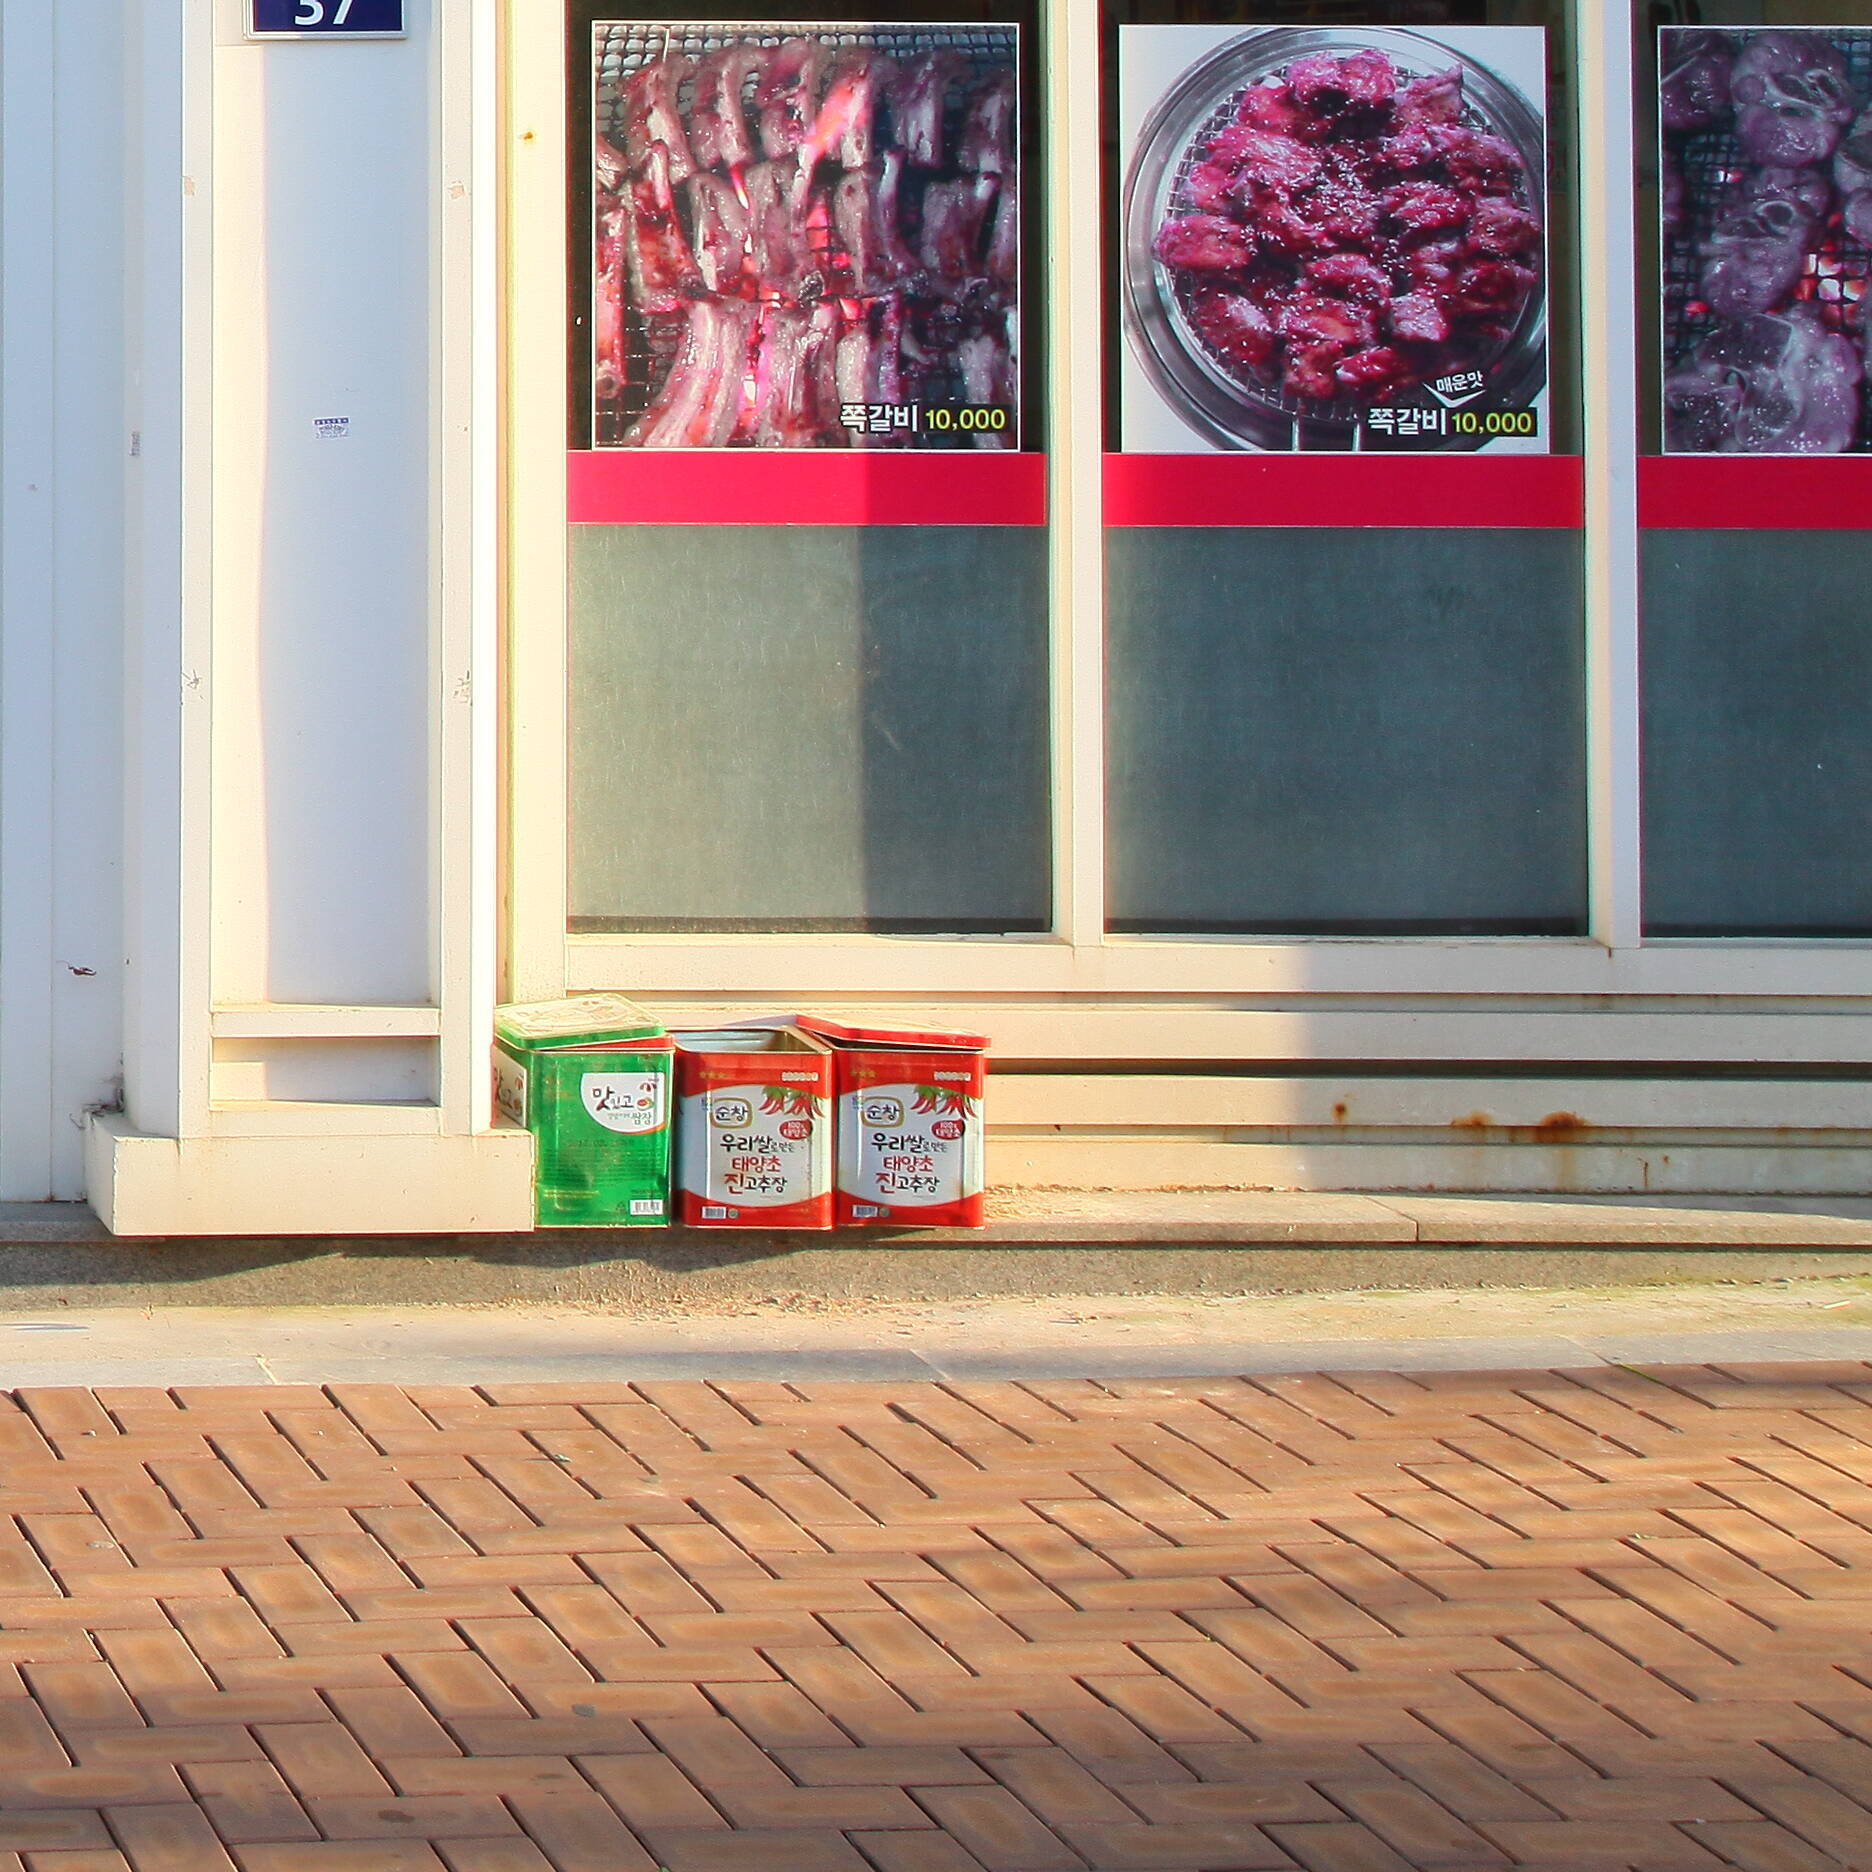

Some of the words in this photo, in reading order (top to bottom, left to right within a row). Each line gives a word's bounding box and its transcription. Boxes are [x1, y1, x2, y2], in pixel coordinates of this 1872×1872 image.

[1435, 370, 1485, 394] 매운맛
[840, 404, 918, 433] 쪽갈비
[924, 408, 1007, 431] 10,000
[1367, 407, 1447, 436] 쪽갈비
[1450, 412, 1533, 435] 10,000
[715, 1105, 748, 1122] 순창
[866, 1104, 901, 1121] 순창
[731, 1155, 782, 1174] 태양초
[883, 1155, 935, 1174] 태양초
